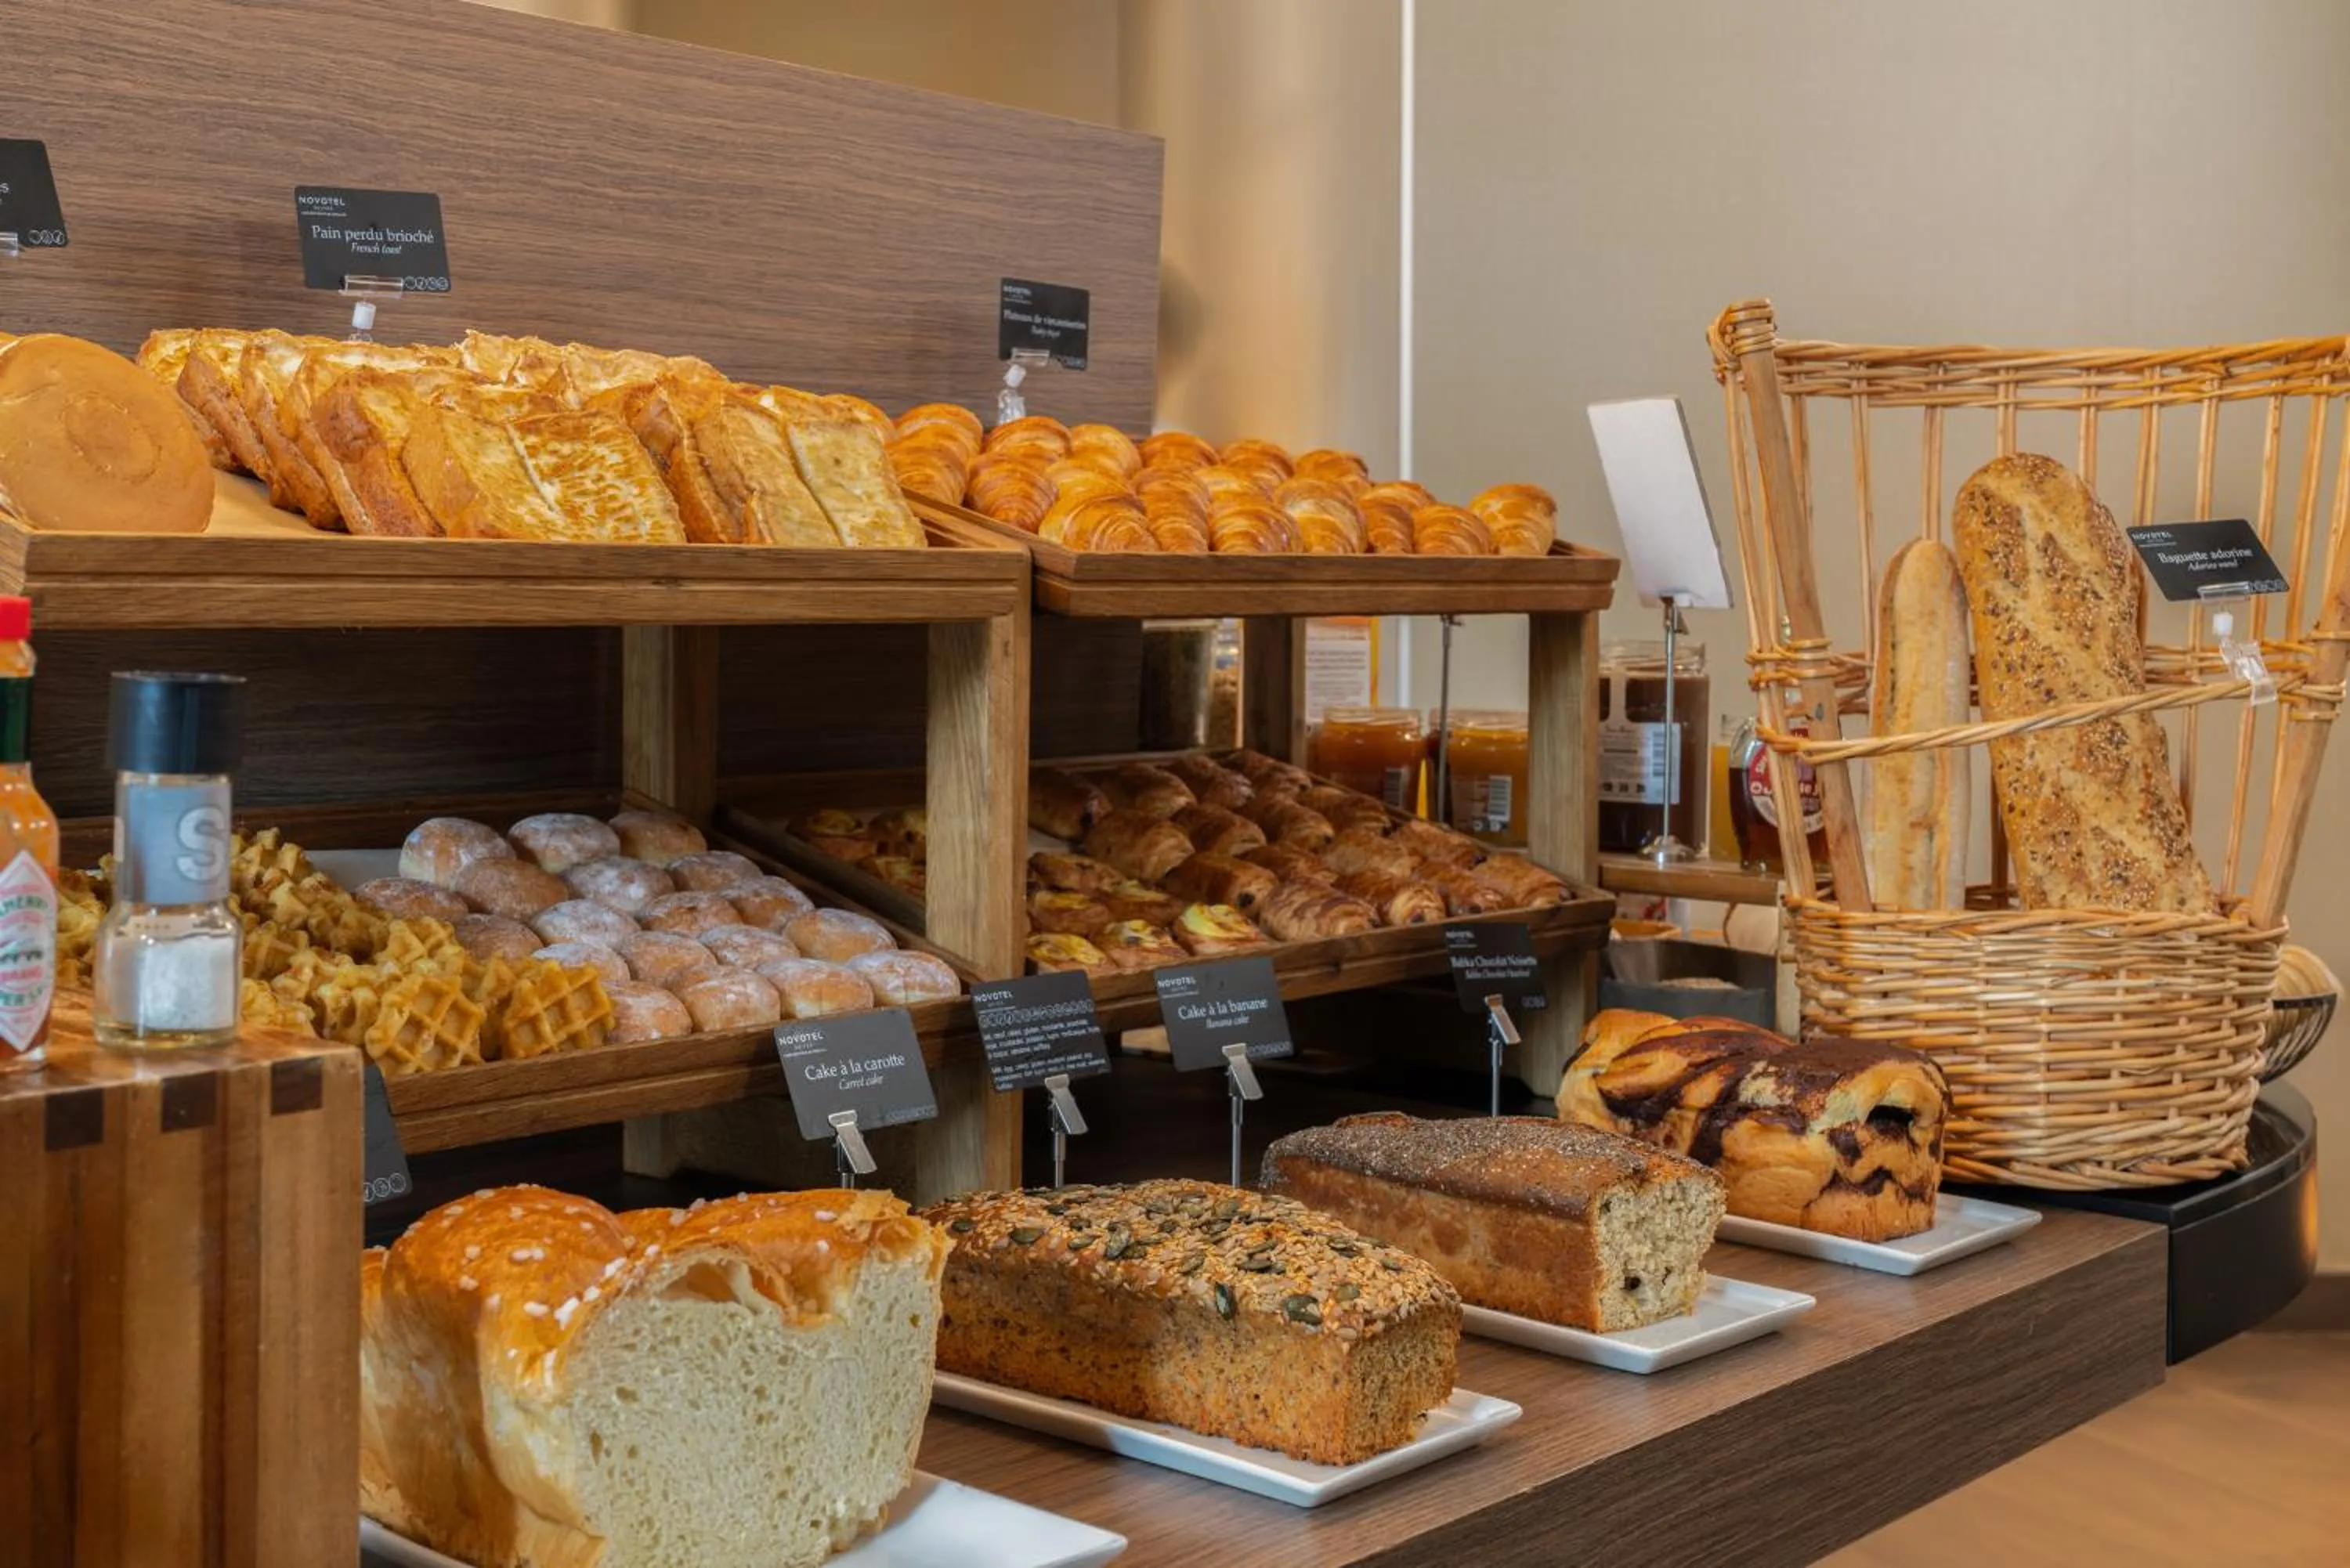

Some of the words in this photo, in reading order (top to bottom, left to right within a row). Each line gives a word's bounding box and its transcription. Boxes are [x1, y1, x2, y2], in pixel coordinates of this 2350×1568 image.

[298, 196, 345, 206] NOVOTEL
[312, 225, 341, 239] Pain
[345, 228, 383, 243] perdu
[386, 229, 434, 244] brioché
[351, 242, 380, 254] French
[2157, 551, 2208, 565] Baguette
[177, 806, 226, 883] S
[1157, 976, 1196, 988] NOVOTEL
[974, 990, 1012, 1003] NOVOTEL
[1178, 1005, 1206, 1020] Cake
[1209, 1002, 1216, 1016] à
[1217, 1002, 1227, 1014] la
[1227, 999, 1268, 1013] banane
[778, 1031, 824, 1046] NOVOTEL
[804, 1063, 837, 1081] Cake
[839, 1059, 848, 1075] à
[849, 1059, 862, 1073] la
[864, 1053, 906, 1071] carotte
